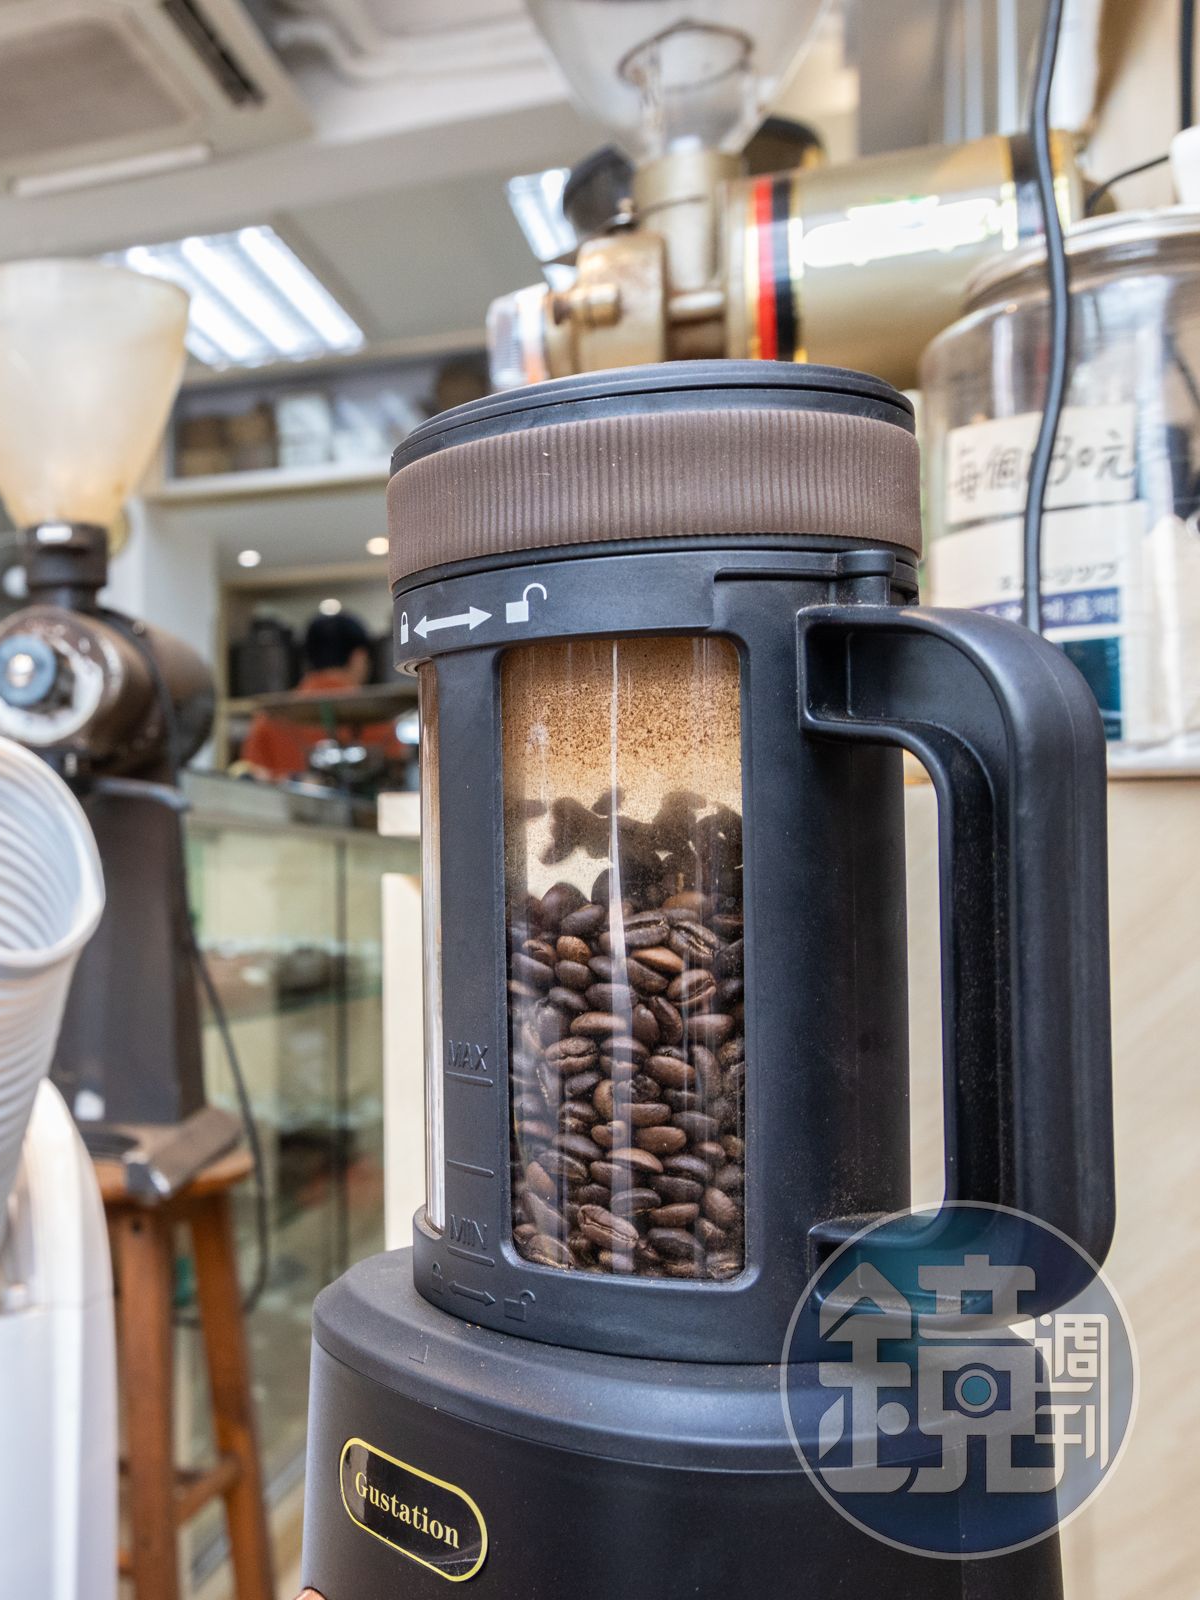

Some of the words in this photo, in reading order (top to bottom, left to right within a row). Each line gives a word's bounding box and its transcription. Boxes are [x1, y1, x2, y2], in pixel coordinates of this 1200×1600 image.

[448, 1039, 489, 1072] MAX
[450, 1213, 488, 1250] MIN
[355, 1471, 460, 1549] Gustation
